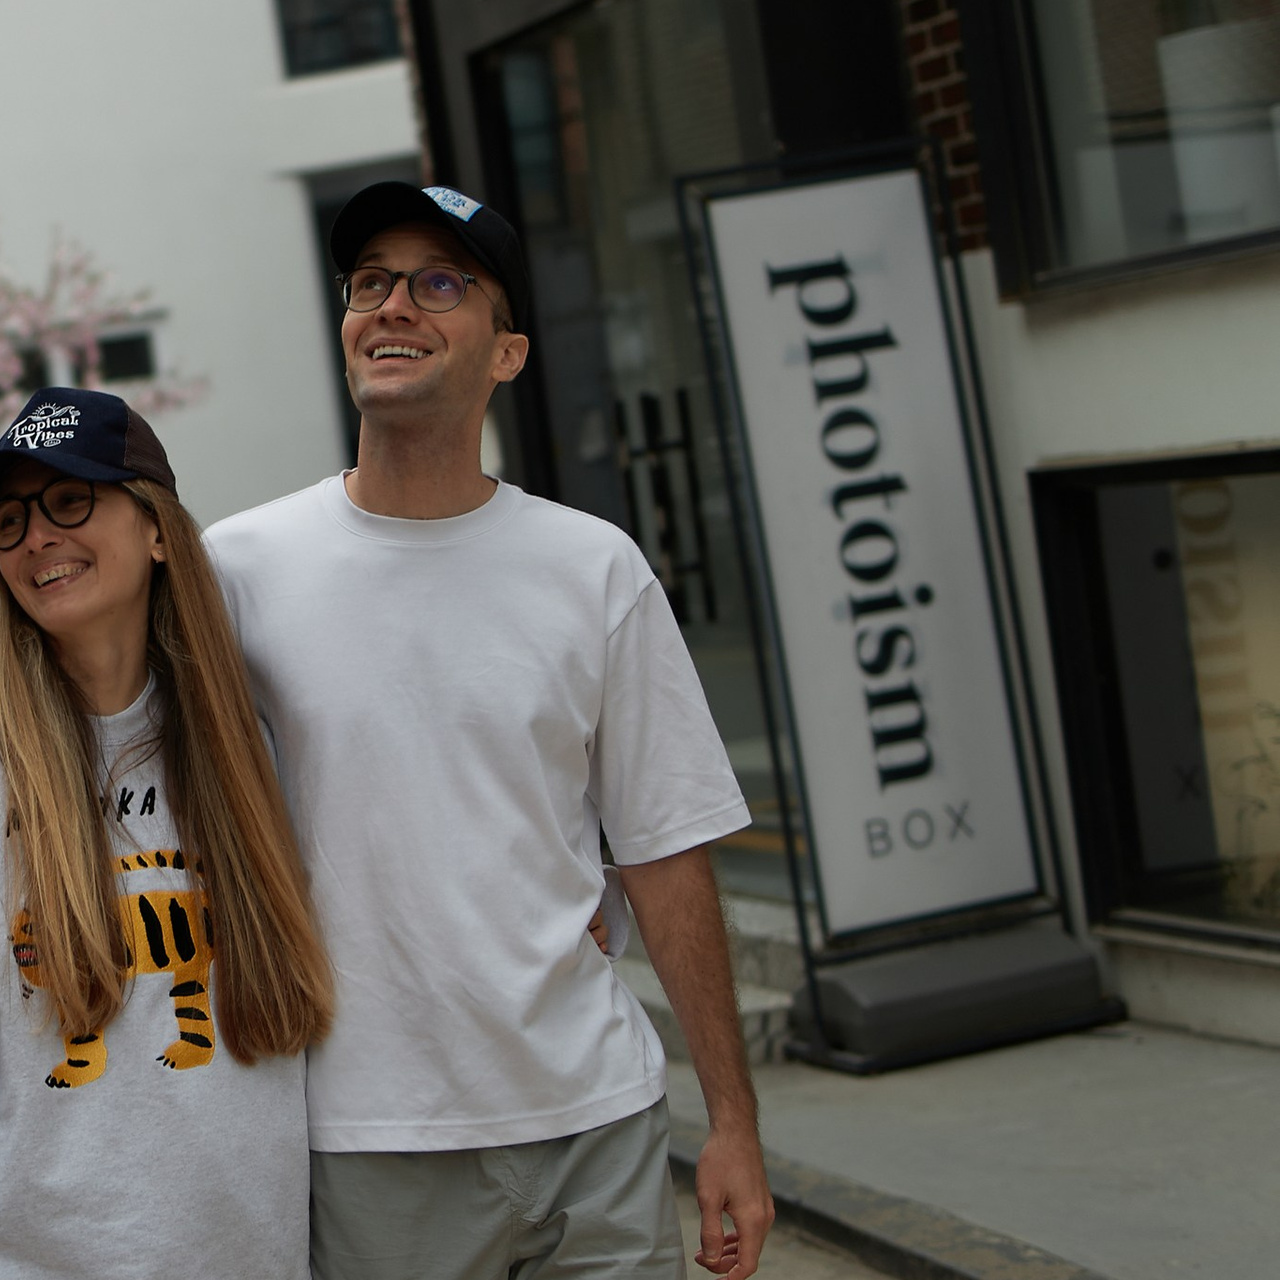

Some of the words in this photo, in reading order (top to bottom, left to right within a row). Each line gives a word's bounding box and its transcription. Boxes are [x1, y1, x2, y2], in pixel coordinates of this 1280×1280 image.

[7, 415, 79, 440] Tropical
[13, 430, 74, 449] Vibes
[767, 253, 935, 792] photoism
[865, 801, 976, 858] BOX
